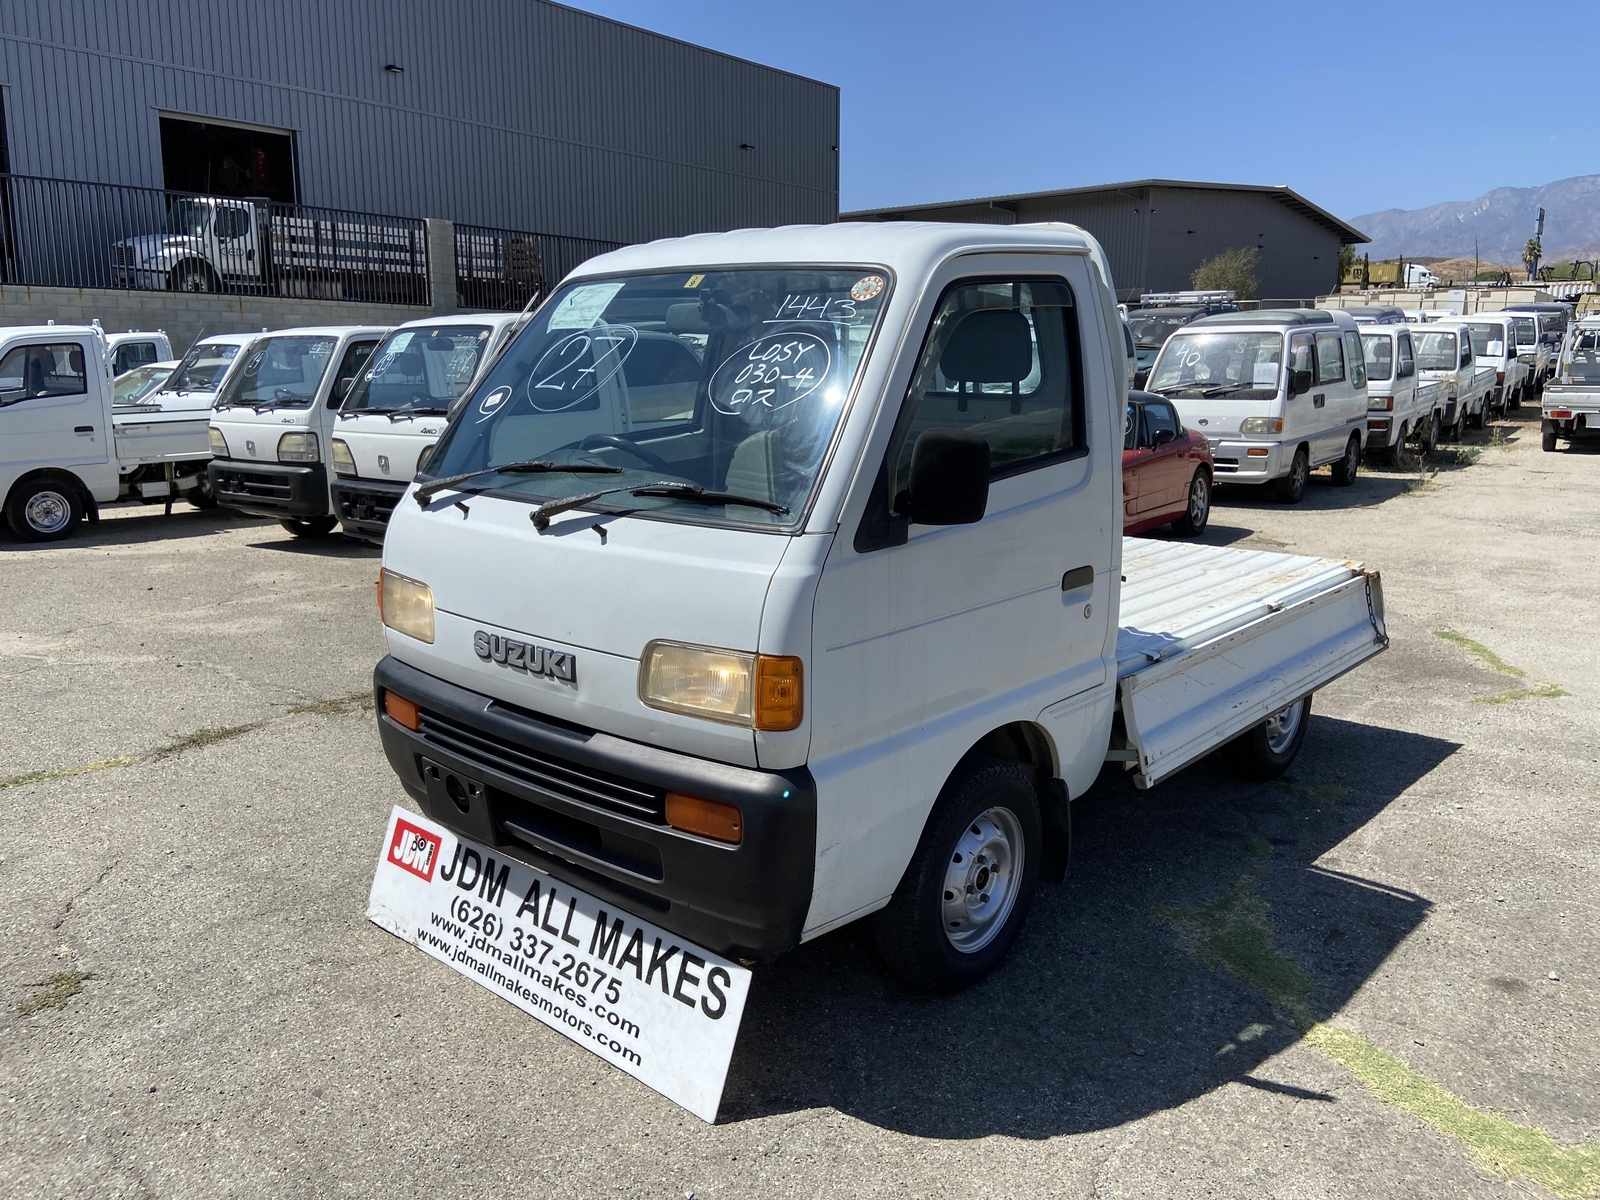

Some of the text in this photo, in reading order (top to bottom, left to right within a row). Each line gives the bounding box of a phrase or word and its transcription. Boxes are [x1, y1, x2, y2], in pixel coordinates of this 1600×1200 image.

[775, 294, 858, 320] 1443
[535, 336, 626, 390] 27
[420, 427, 437, 435] 4WD
[473, 630, 577, 684] SUZUKI
[393, 828, 436, 875] JDM
[441, 843, 732, 1020] JDM ALL MAKES
[450, 895, 622, 1004] (626) 337-2675
[416, 928, 642, 1067] www.jdmallmakesmotors.com
[430, 911, 641, 1039] www.jdmallmakes.com
